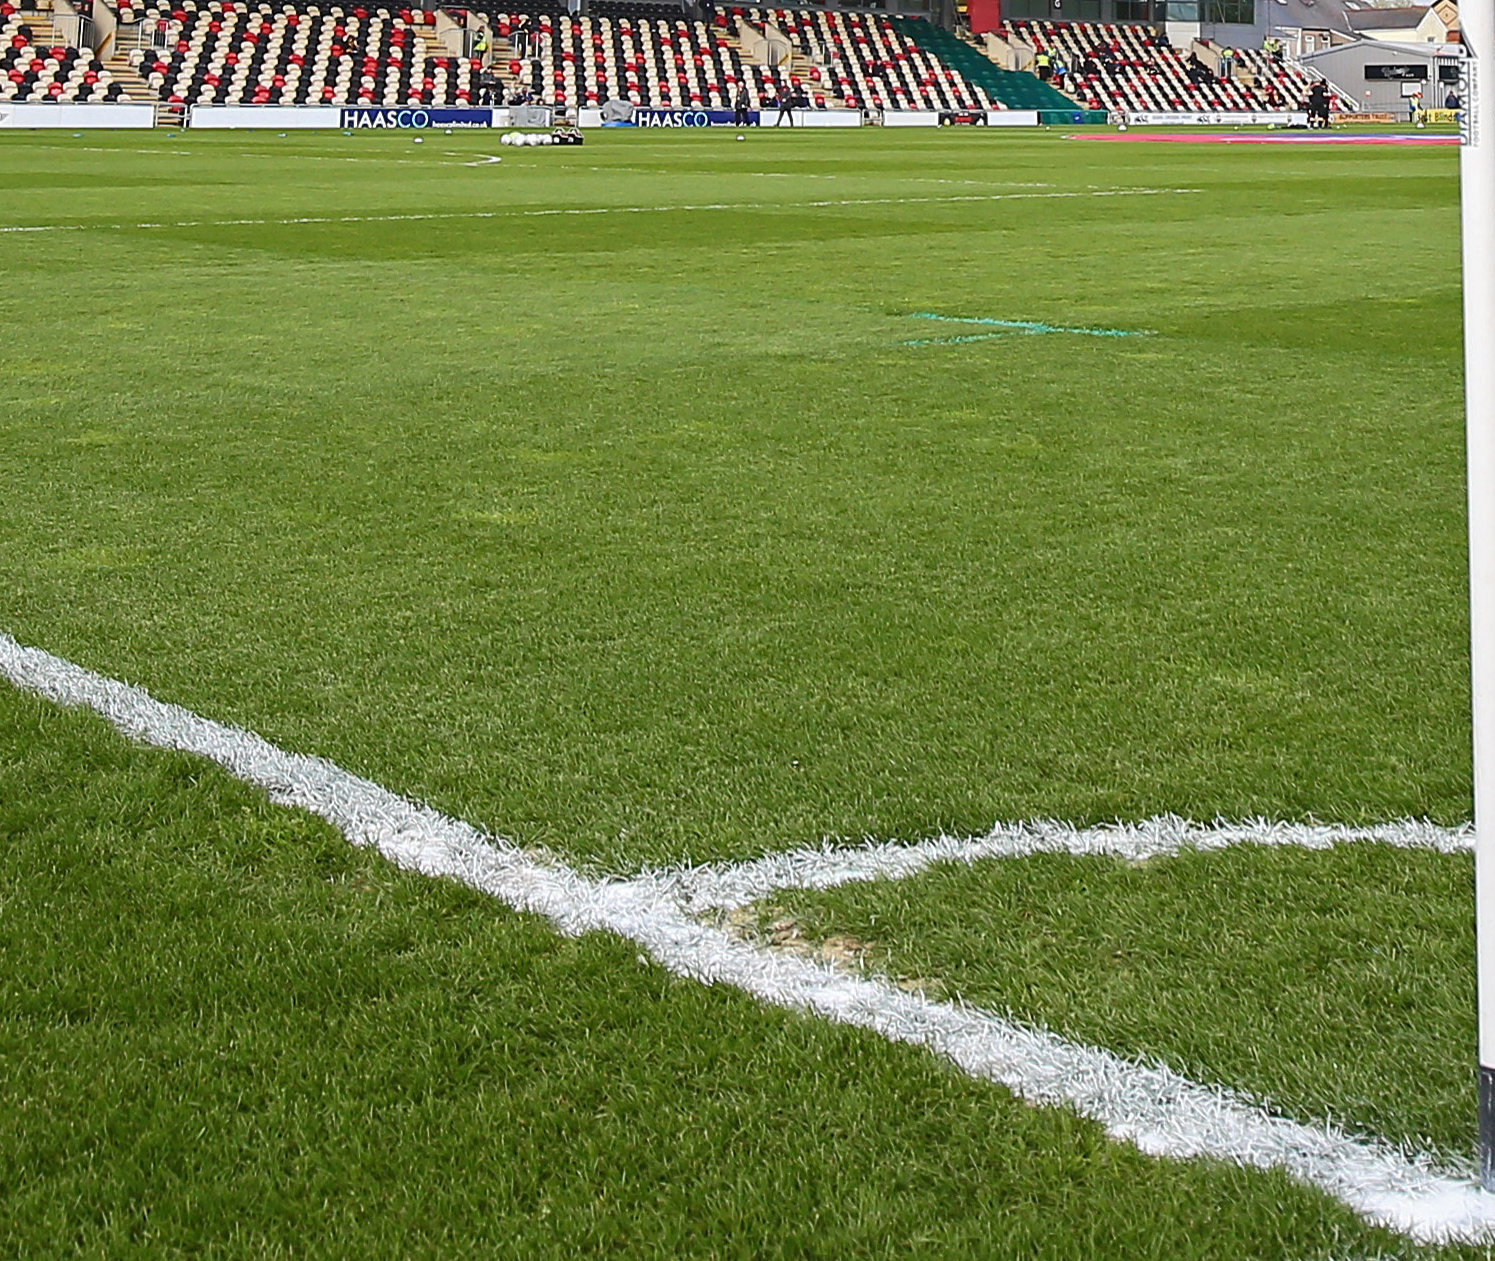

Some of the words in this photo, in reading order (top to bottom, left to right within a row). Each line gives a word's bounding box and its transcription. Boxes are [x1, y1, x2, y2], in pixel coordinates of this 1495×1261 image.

[1054, 0, 1061, 8] G
[344, 110, 429, 128] HAASCO
[638, 111, 709, 127] HAASCO
